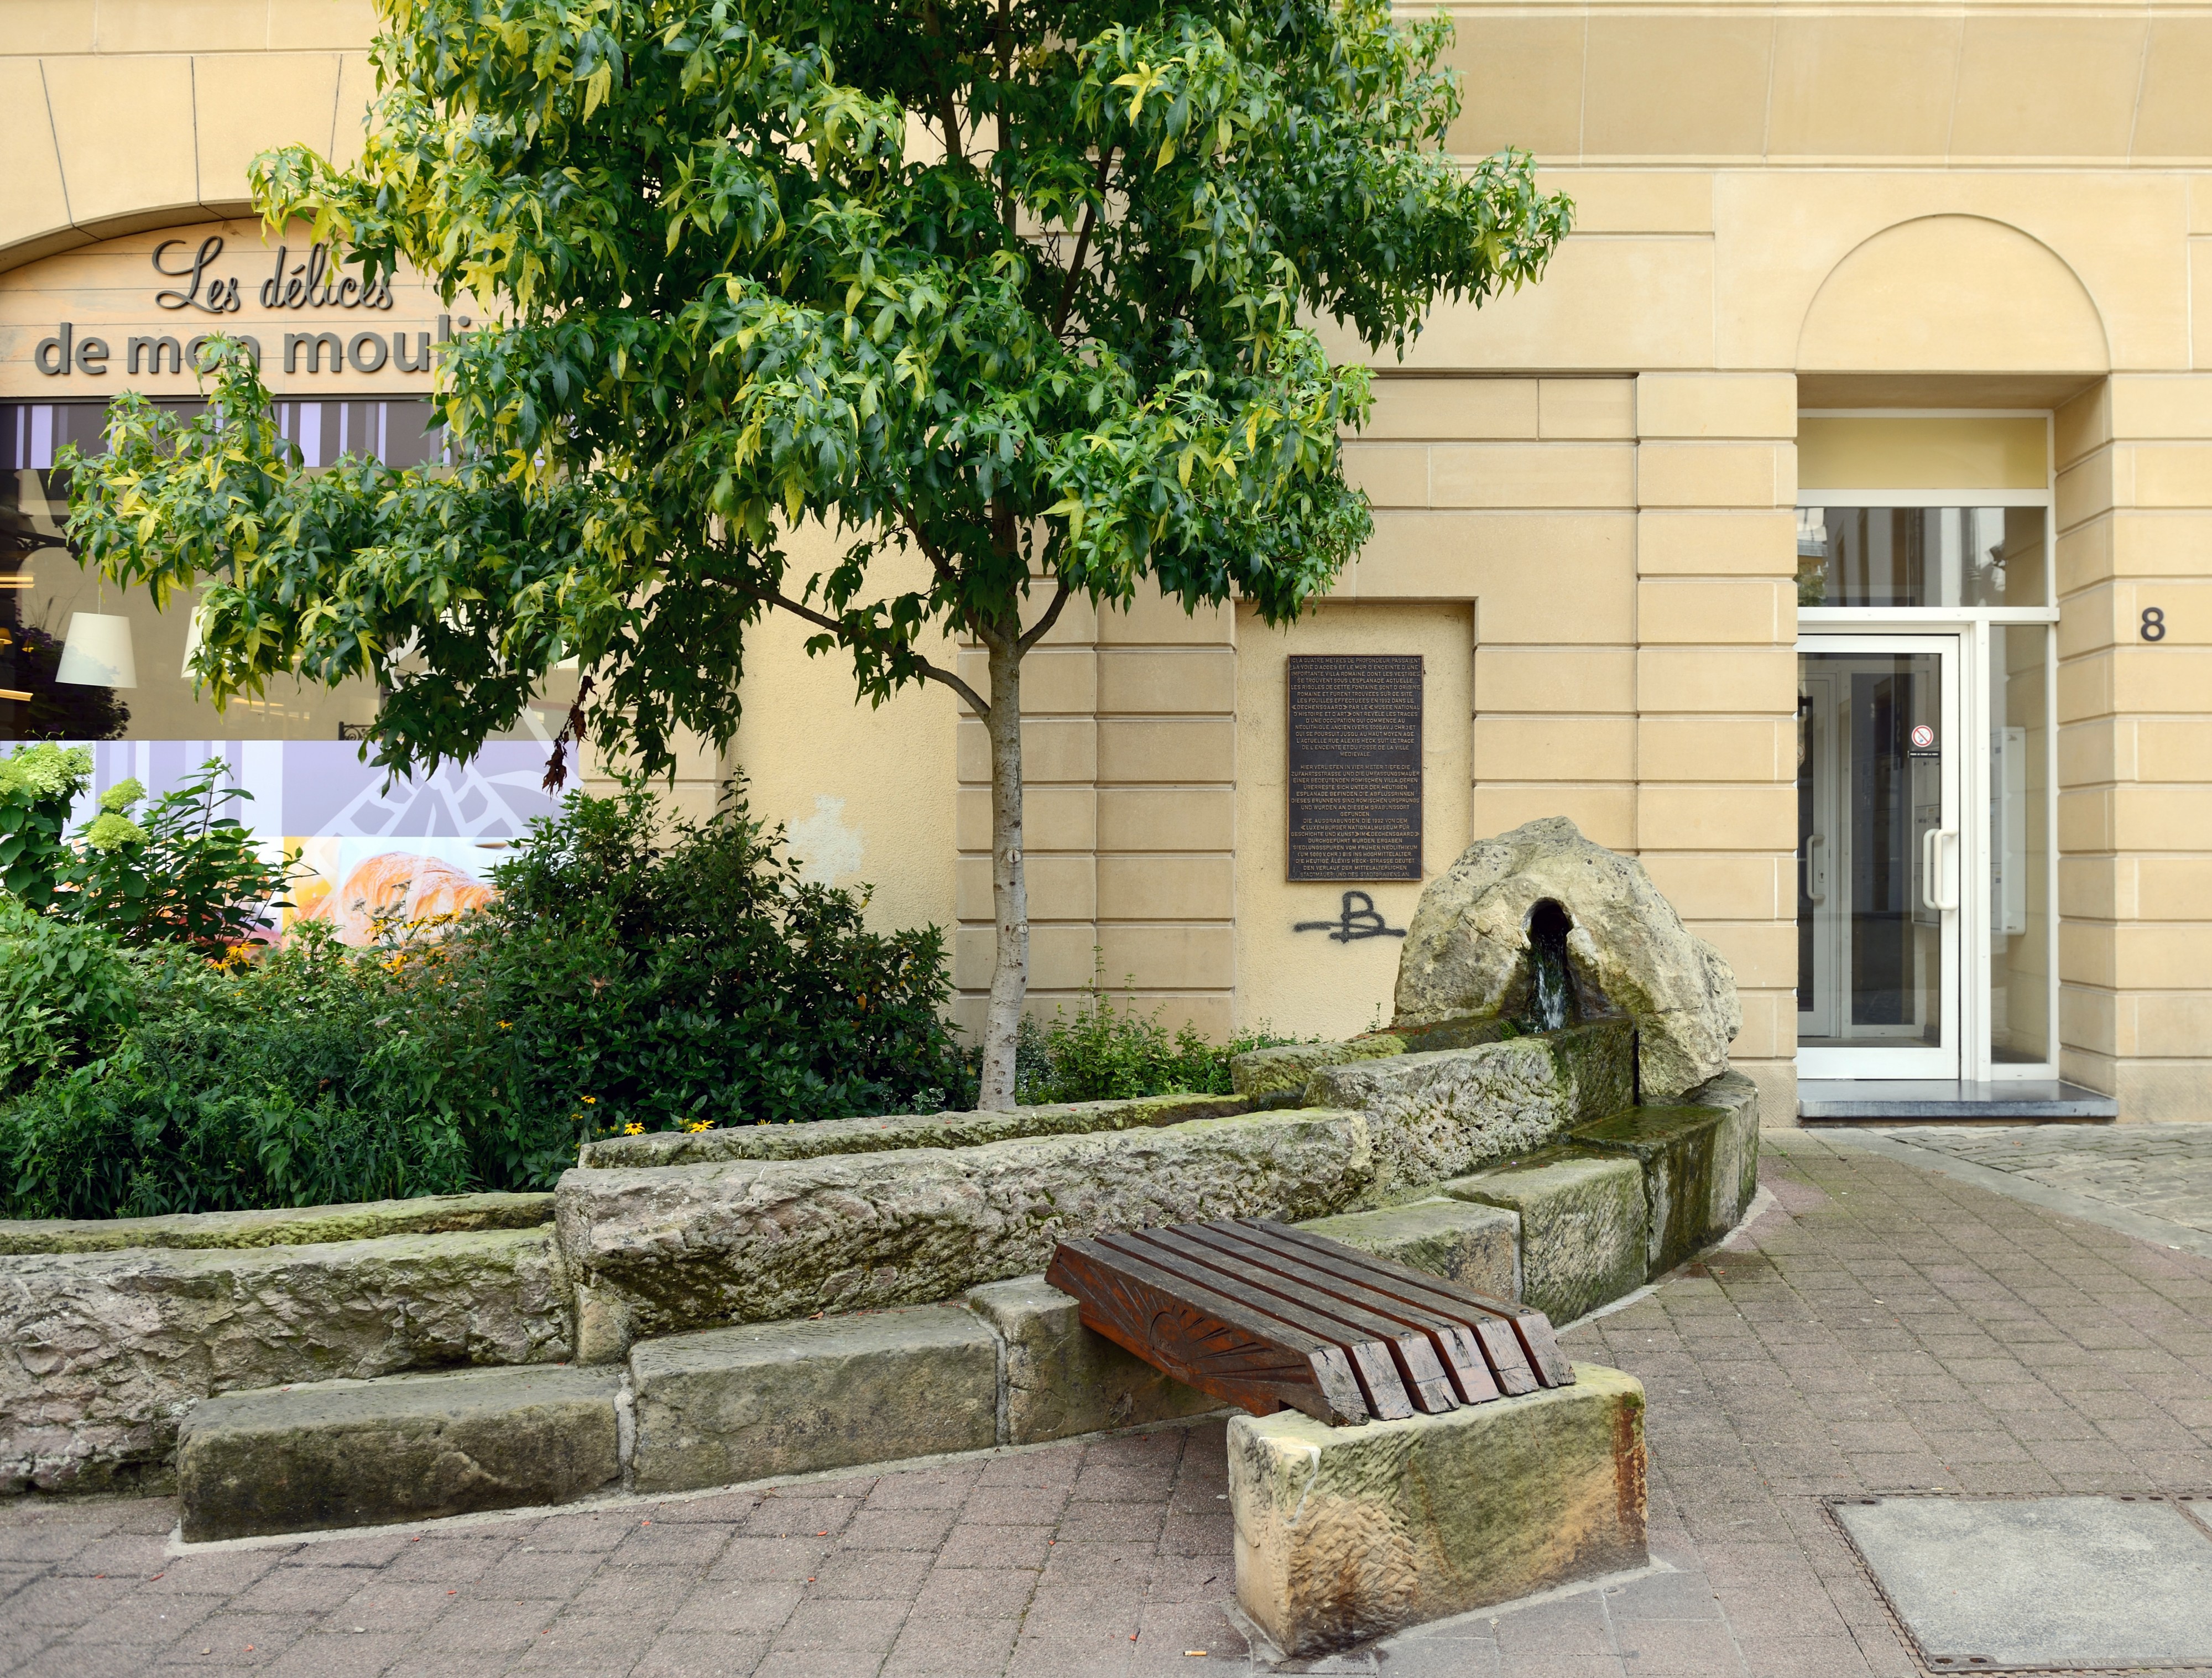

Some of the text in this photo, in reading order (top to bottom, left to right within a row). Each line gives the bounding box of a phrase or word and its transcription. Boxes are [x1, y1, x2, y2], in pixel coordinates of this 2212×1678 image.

[152, 235, 393, 314] Les délices
[34, 322, 109, 376] de
[127, 335, 260, 374] mon
[2141, 607, 2166, 642] 8
